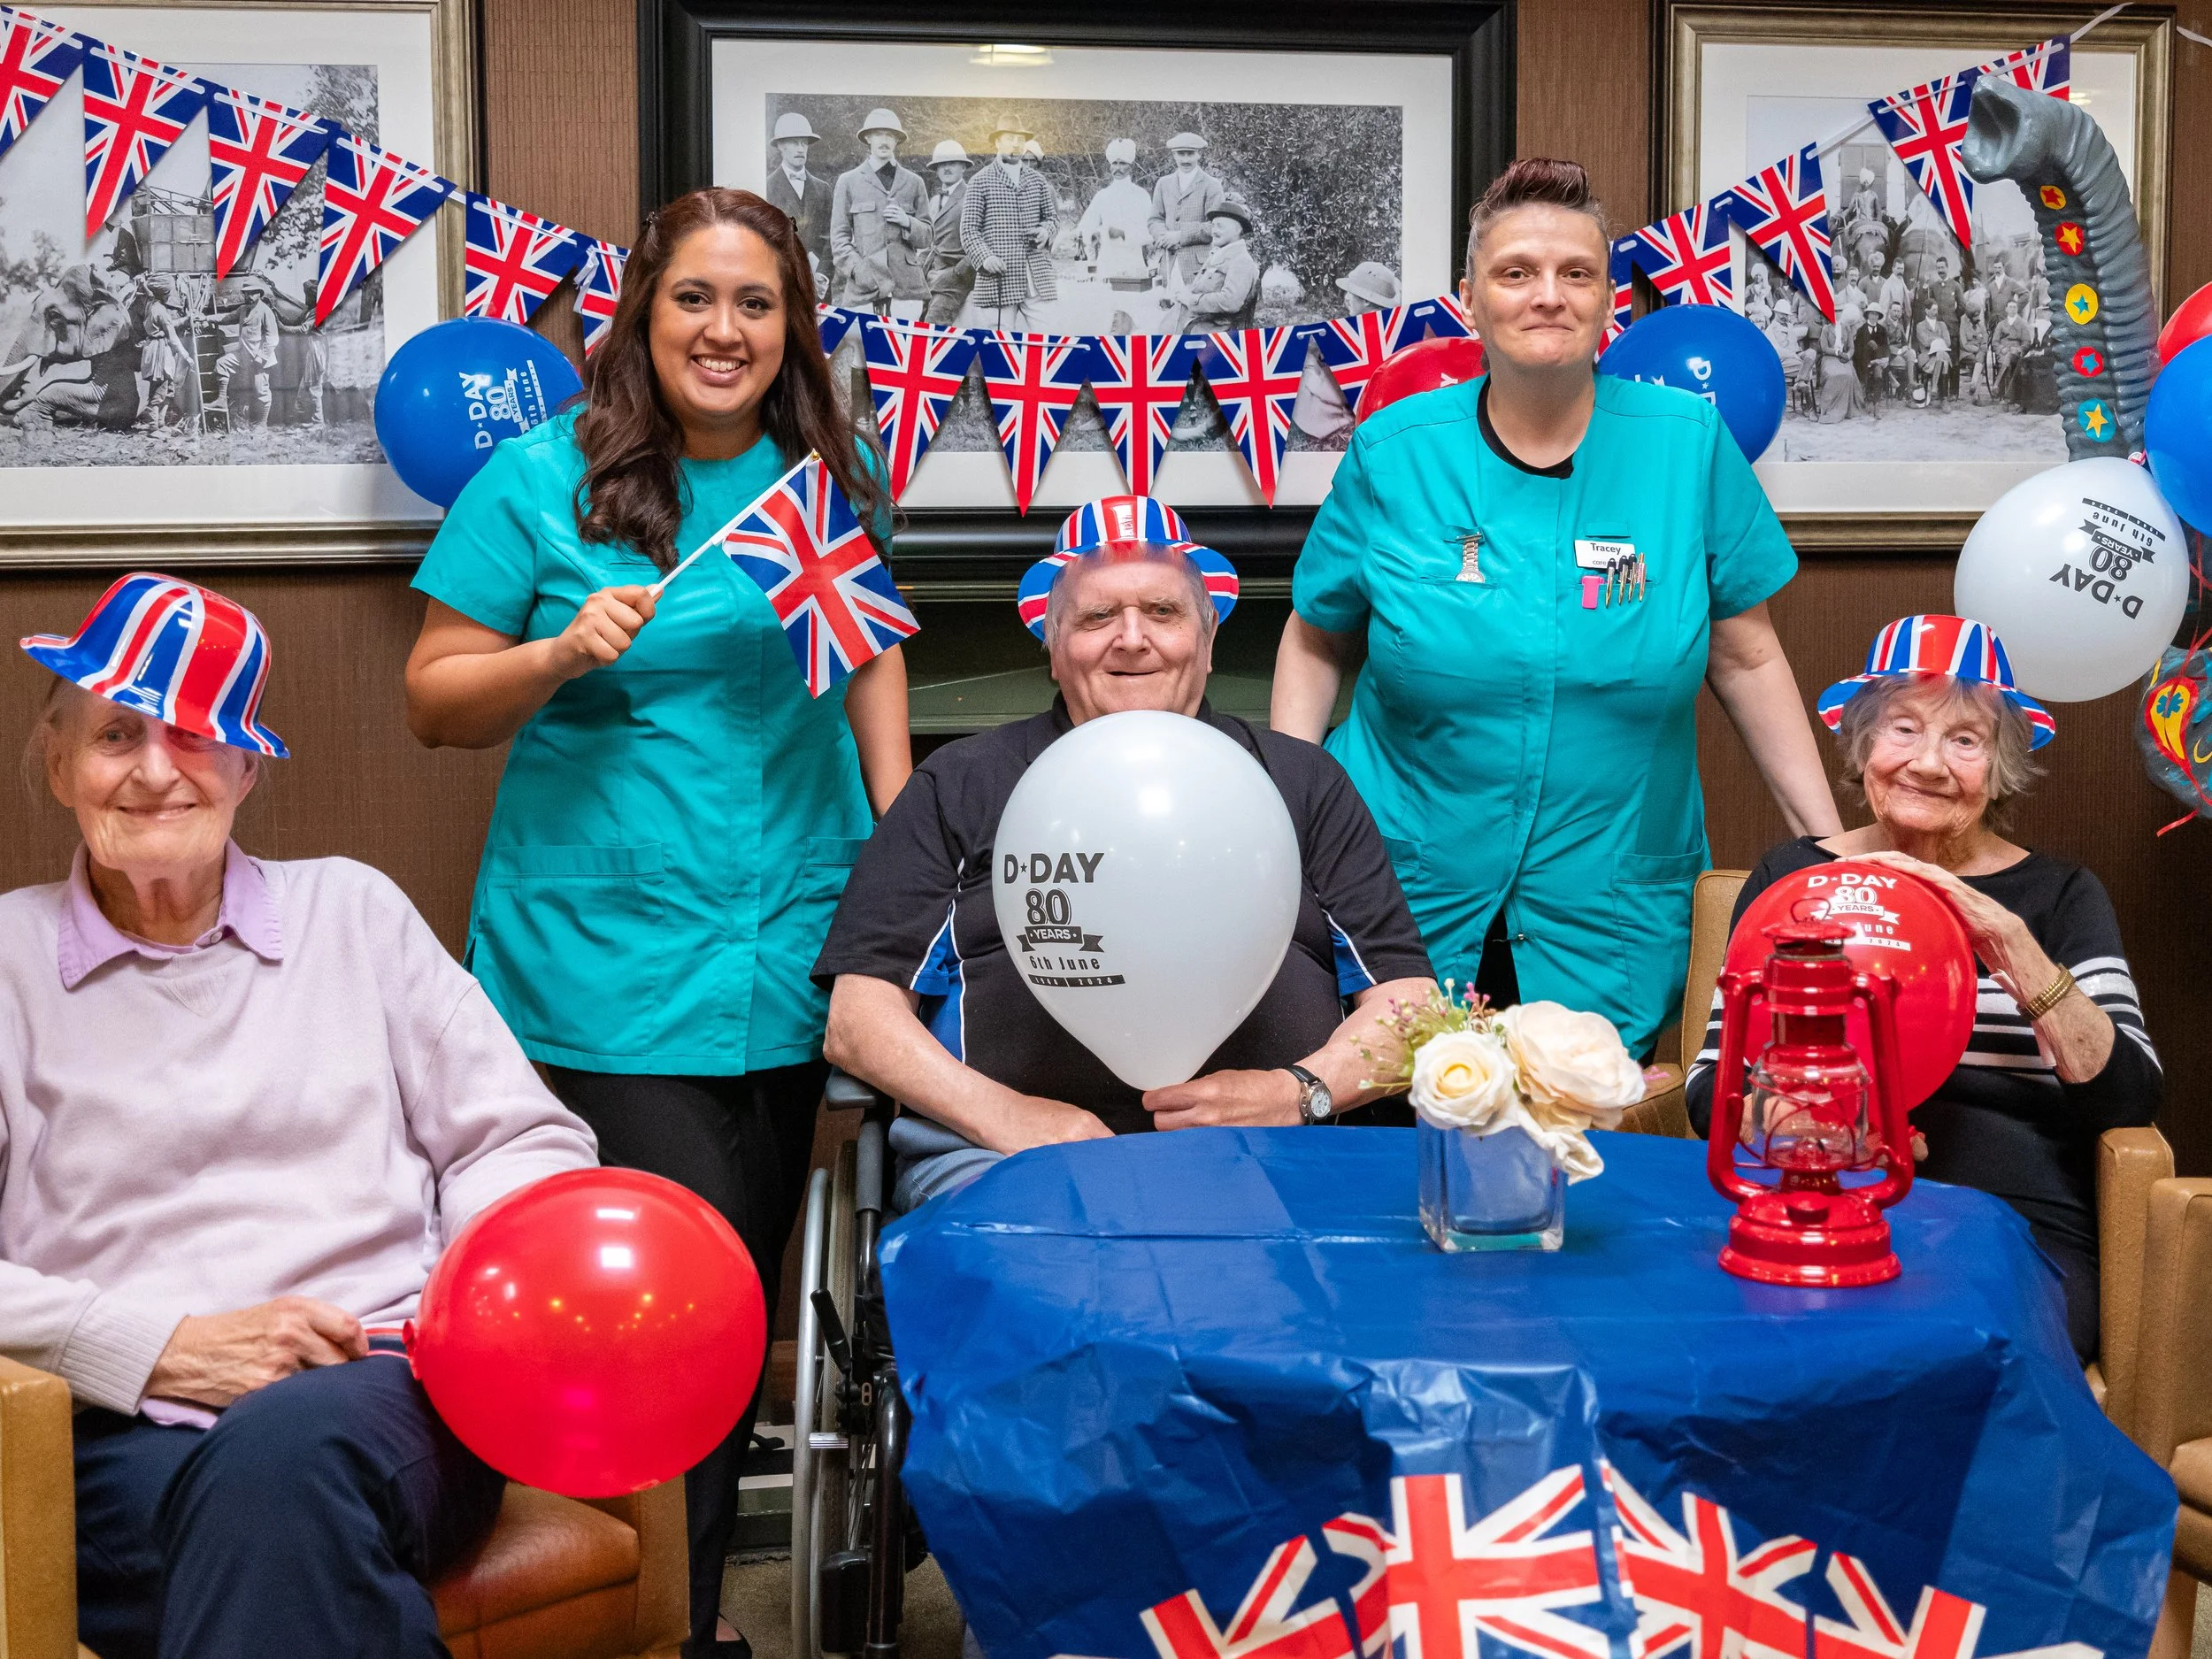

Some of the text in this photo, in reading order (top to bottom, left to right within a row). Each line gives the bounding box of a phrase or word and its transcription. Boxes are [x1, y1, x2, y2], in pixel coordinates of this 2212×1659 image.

[486, 386, 512, 421] 80
[508, 387, 518, 415] YEARS
[2093, 511, 2153, 547] 6th June
[1590, 542, 1621, 555] Tracey
[2101, 536, 2133, 557] YEARS
[2089, 546, 2132, 582] 80
[1834, 886, 1877, 904] 80
[1025, 888, 1071, 926] 80
[1033, 929, 1071, 940] YEARS
[1029, 956, 1100, 970] 6th June
[1079, 977, 1113, 986] 2024
